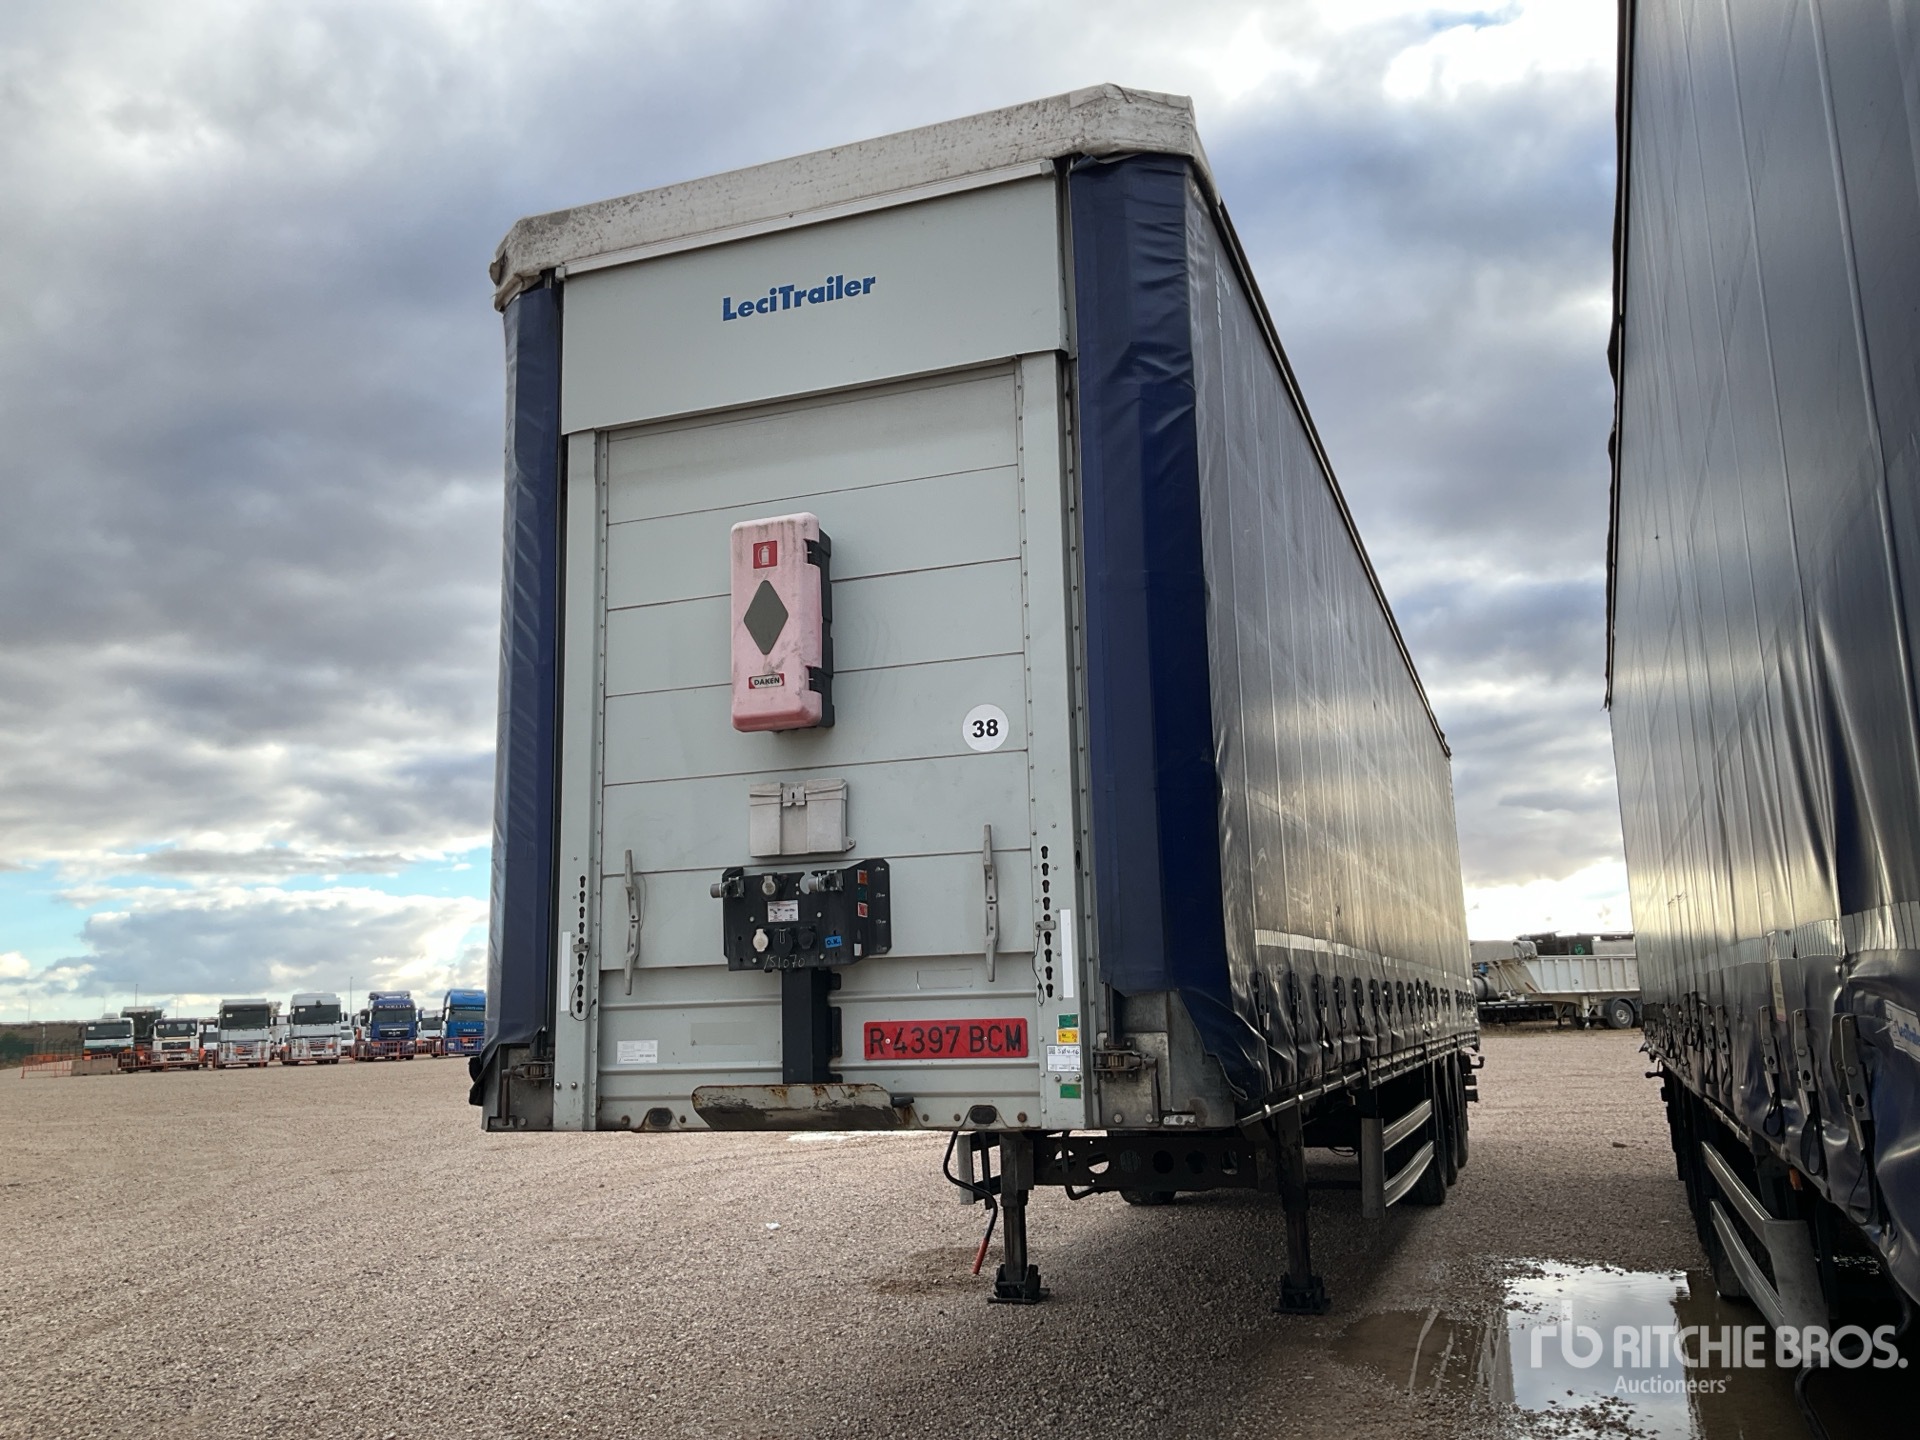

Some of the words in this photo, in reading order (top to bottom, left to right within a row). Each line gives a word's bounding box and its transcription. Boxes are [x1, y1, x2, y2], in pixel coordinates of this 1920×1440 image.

[723, 275, 876, 321] LeciTrailer
[754, 676, 780, 686] DAKEN
[972, 719, 999, 738] 38
[869, 1028, 885, 1055] R
[893, 1025, 961, 1054] 4397
[969, 1024, 1022, 1053] BCM
